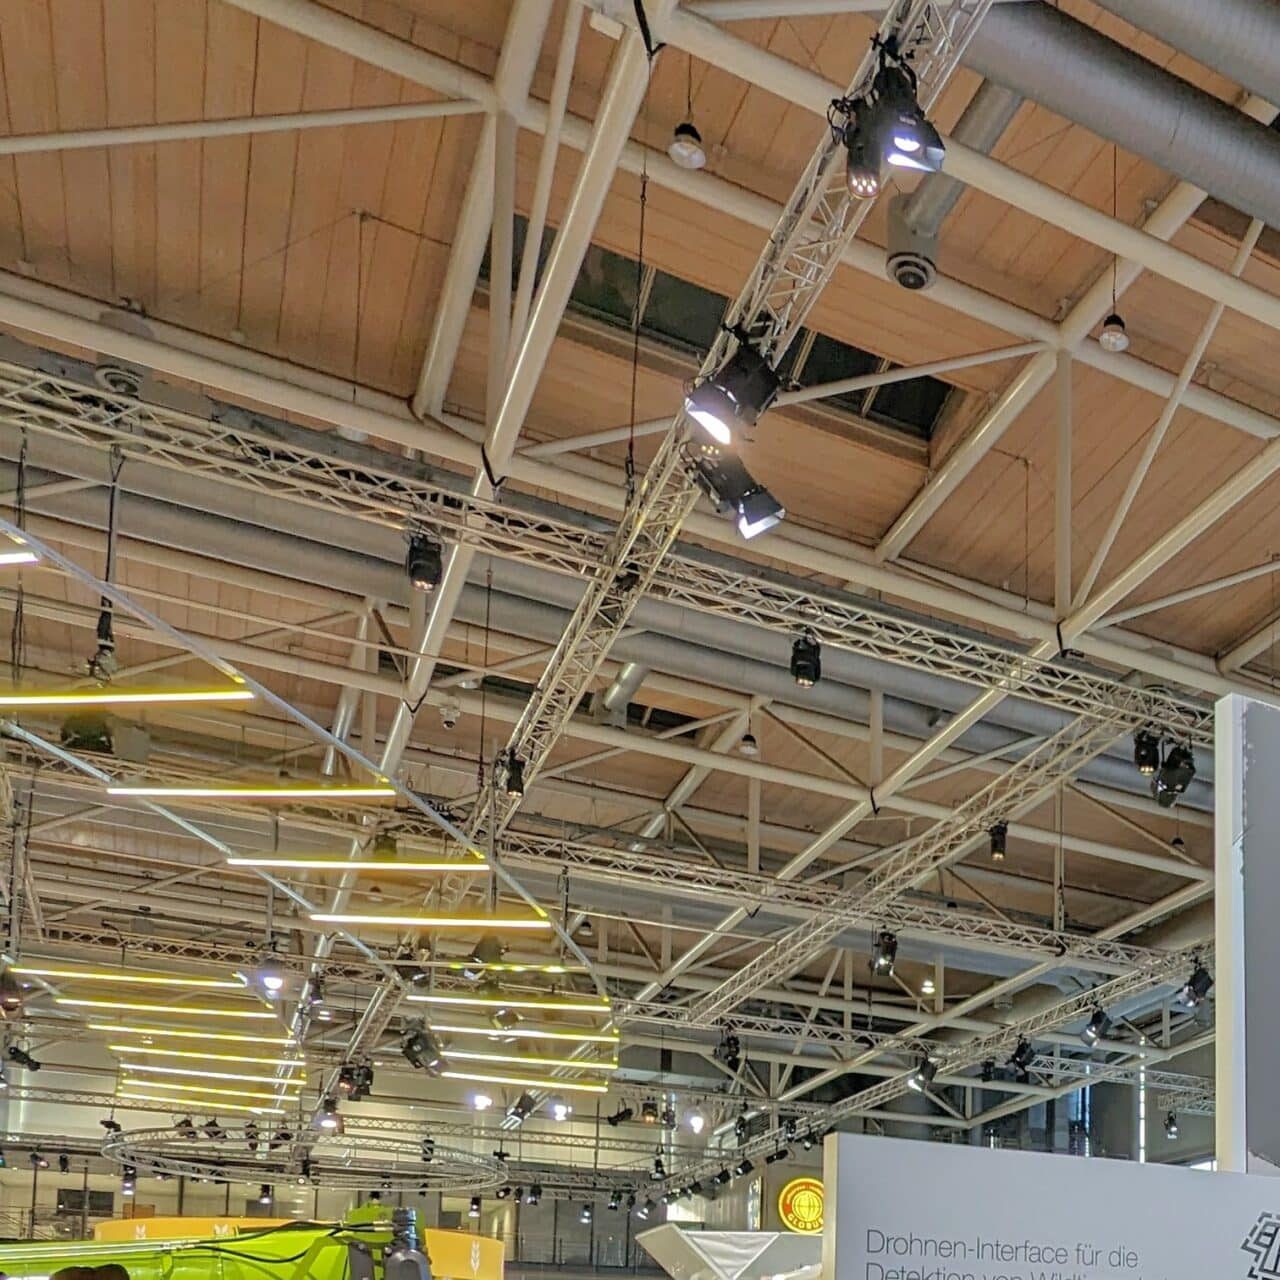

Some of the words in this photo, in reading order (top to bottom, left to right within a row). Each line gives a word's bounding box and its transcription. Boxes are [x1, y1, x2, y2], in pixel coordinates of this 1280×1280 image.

[866, 1229, 1068, 1264] Drohnen-Interface
[1076, 1243, 1102, 1266] für
[1108, 1246, 1138, 1268] die
